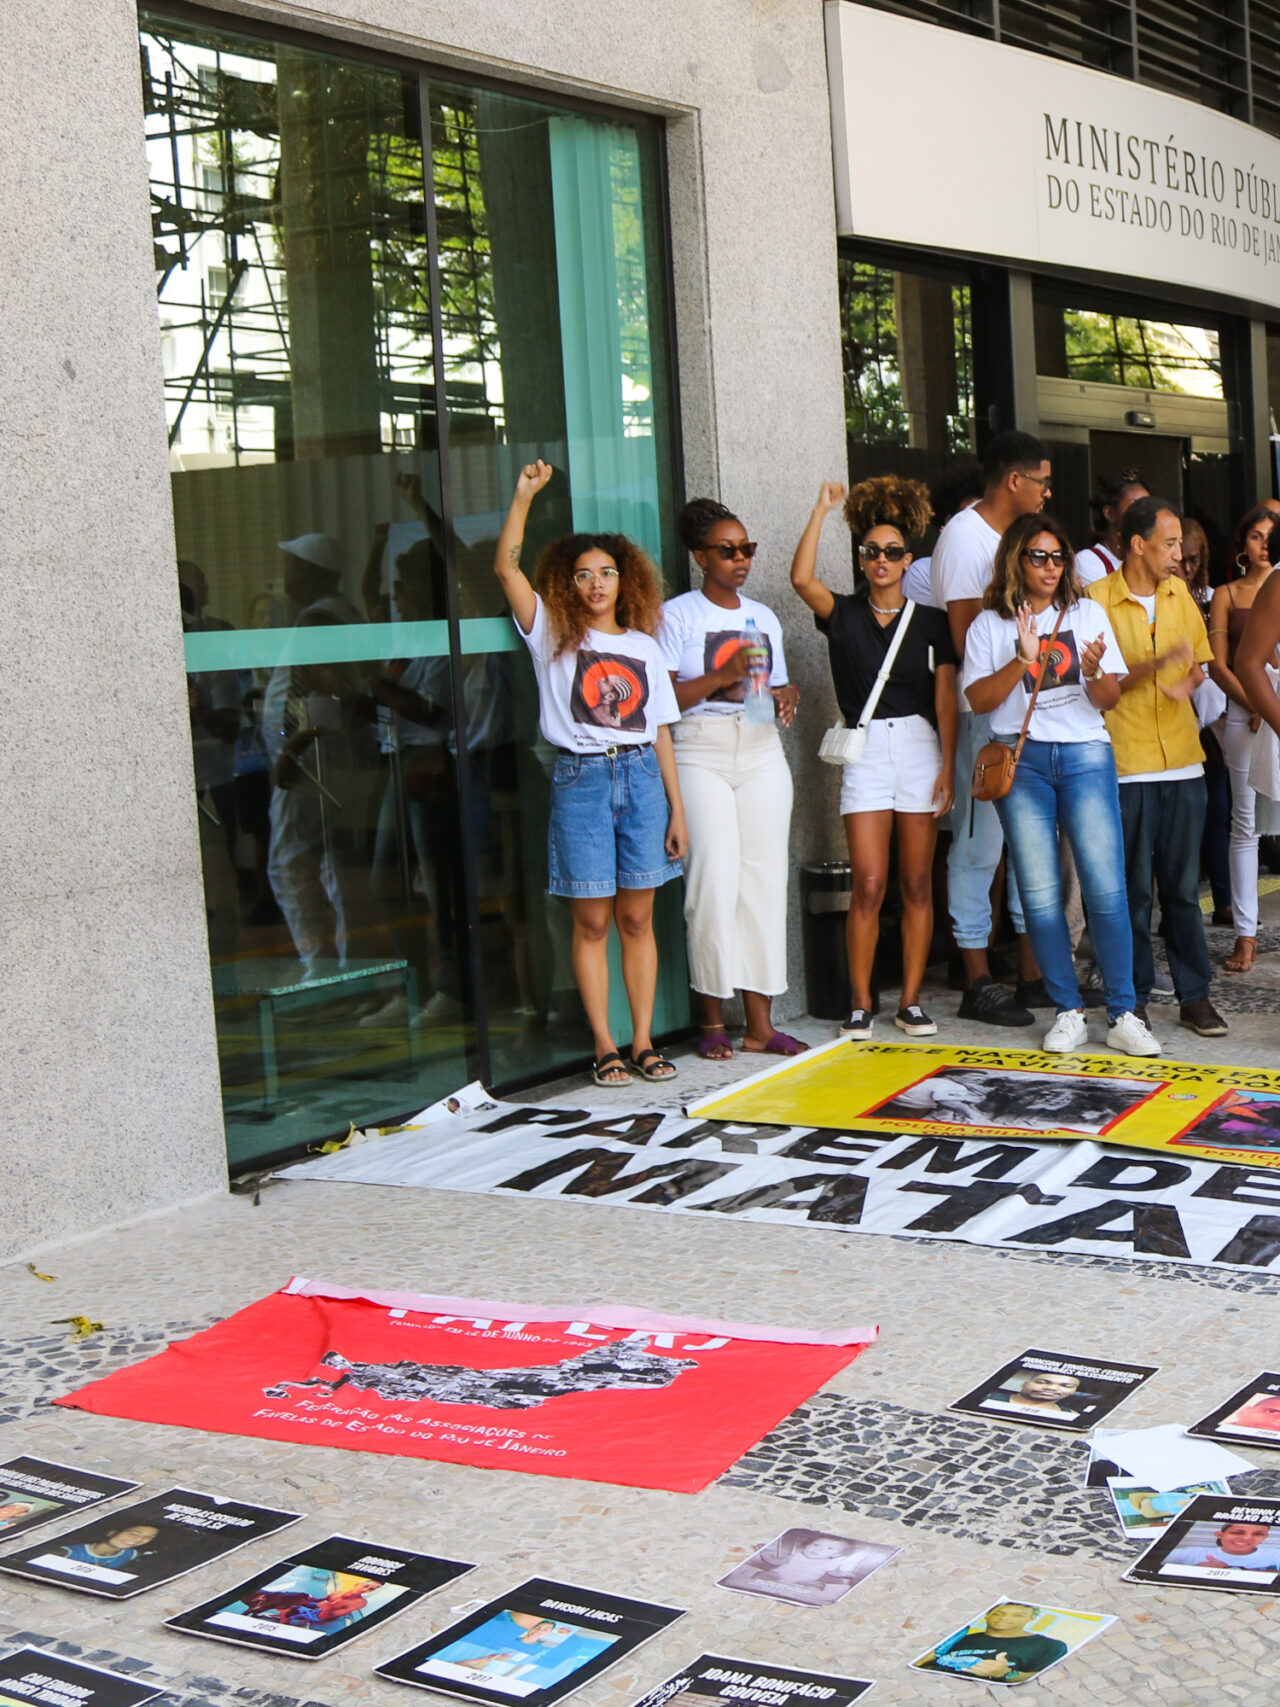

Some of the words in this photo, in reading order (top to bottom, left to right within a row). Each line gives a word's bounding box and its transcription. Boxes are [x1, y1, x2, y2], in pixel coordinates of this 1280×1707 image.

[1043, 112, 1225, 203] MINISTÉRIO
[1047, 174, 1080, 213] DO
[1089, 183, 1172, 232] ESTADO
[1180, 205, 1204, 240] DO
[1211, 213, 1238, 249] RIO
[1242, 223, 1260, 257] DE
[858, 1045, 948, 1057] REDE
[954, 1049, 1132, 1071] NACIONAL
[1169, 1064, 1219, 1077] DOS
[958, 1056, 999, 1067] DA
[1005, 1059, 1205, 1084] VIOLÊNCIA
[470, 1106, 1040, 1181] PAREM
[481, 1330, 499, 1338] DE
[501, 1330, 542, 1343] JUNHO
[1230, 1506, 1275, 1517] DEVONN
[1259, 1516, 1274, 1524] DE
[539, 1598, 591, 1616] DAVISON
[586, 1609, 624, 1623] LUCAS
[698, 1667, 754, 1686] JOANA
[749, 1675, 837, 1700] BONIFÁCIO
[719, 1684, 790, 1706] GOUVEIA
